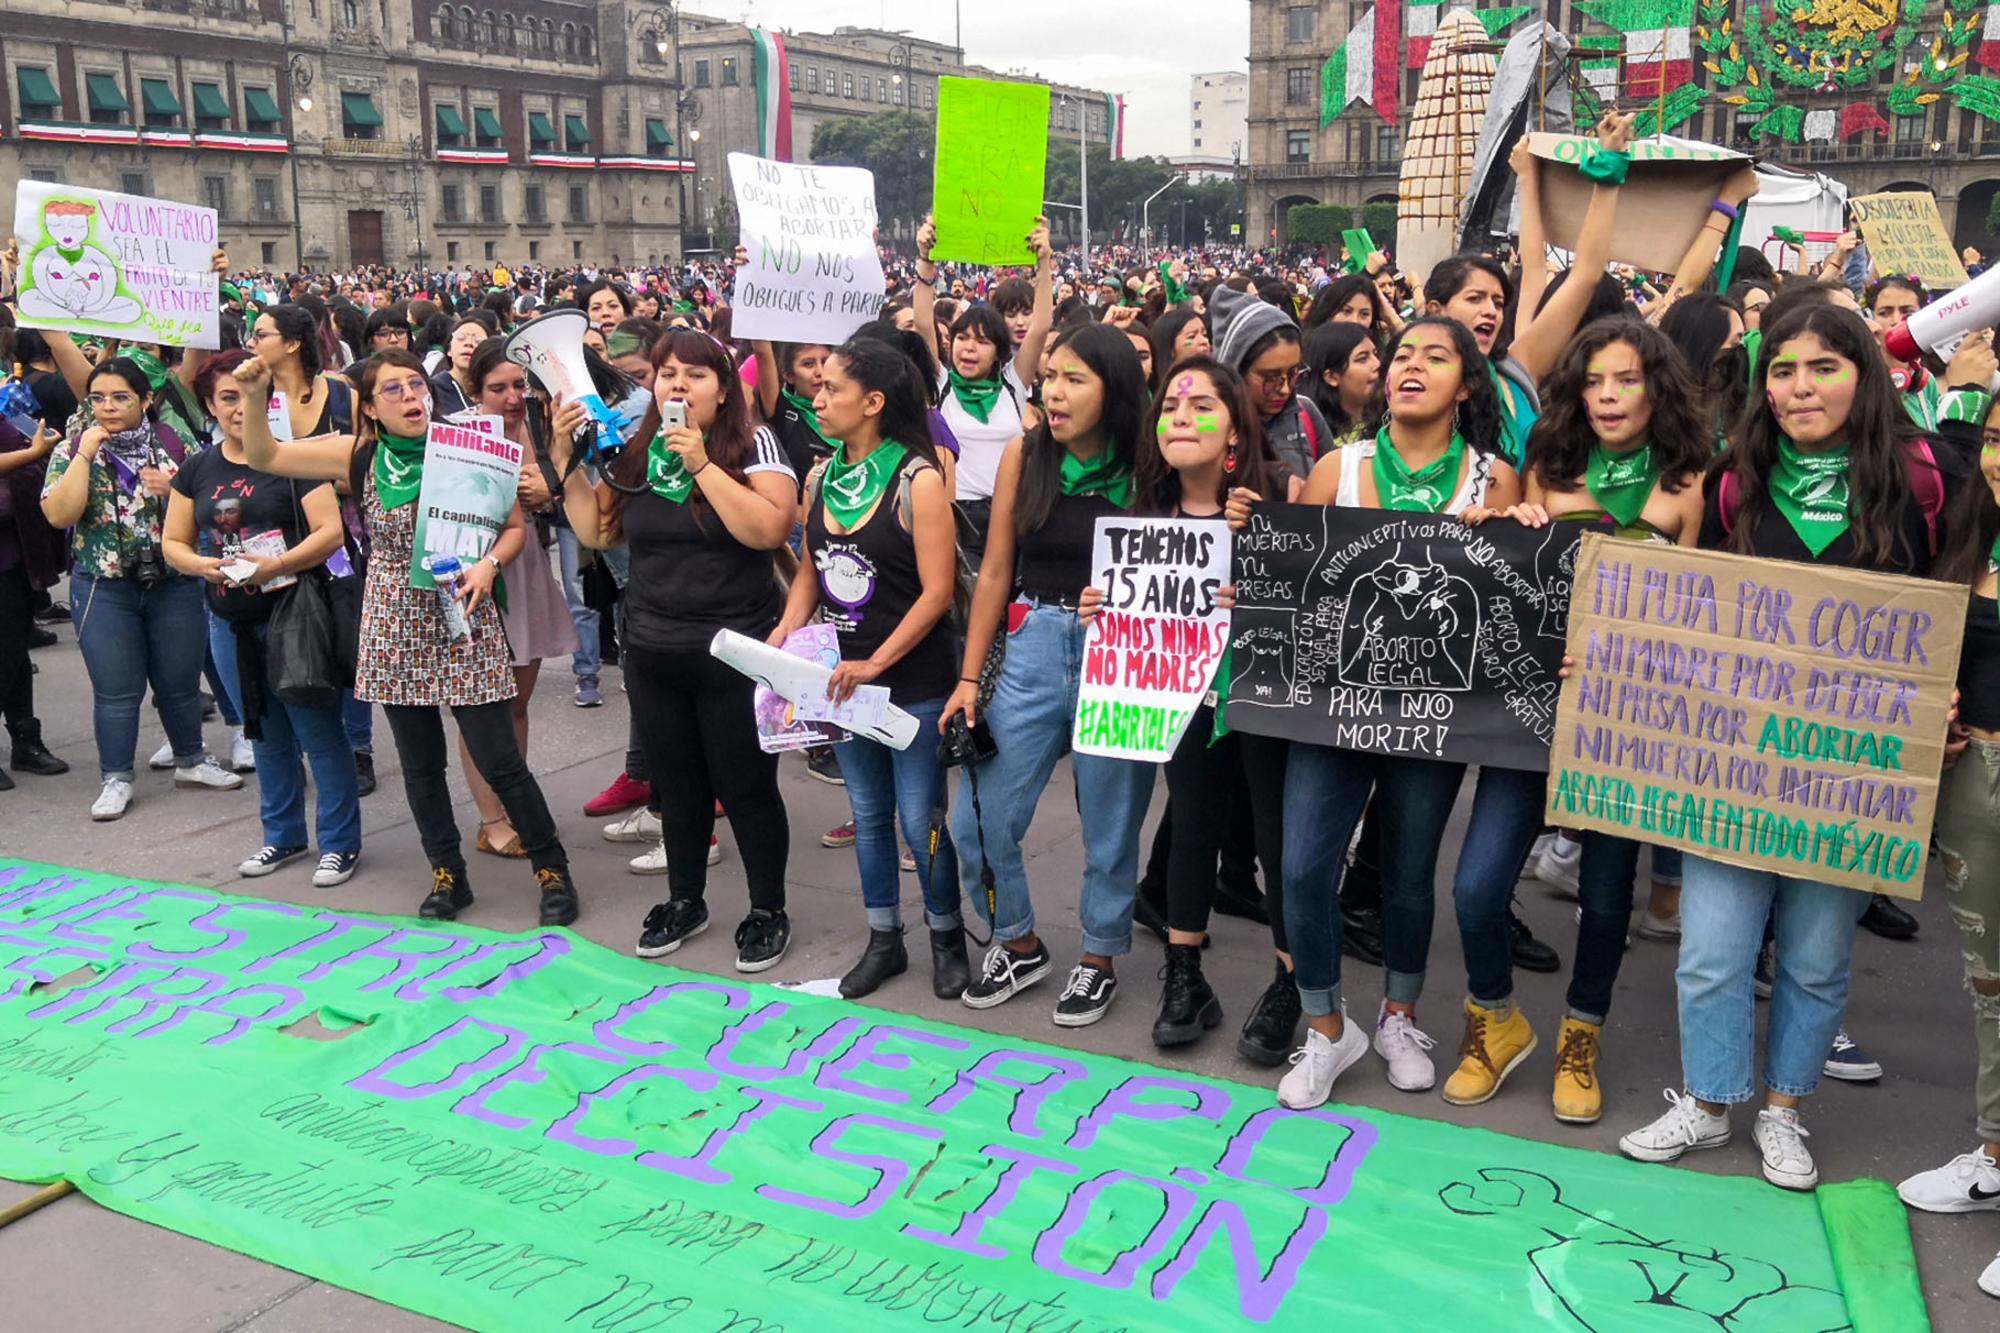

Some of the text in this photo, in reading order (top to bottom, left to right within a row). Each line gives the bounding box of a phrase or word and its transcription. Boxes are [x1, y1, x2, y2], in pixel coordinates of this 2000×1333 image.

[757, 161, 827, 189] NO TE
[742, 182, 875, 217] OBLIGAMOS A
[960, 185, 1002, 219] NO
[98, 200, 214, 244] VOLUNTARIO
[780, 215, 871, 240] ABORTAR
[113, 236, 176, 265] SEA EL
[761, 235, 854, 283] NO NOS
[125, 265, 214, 289] FRUTO DE TU
[743, 282, 815, 315] OBLIGUES
[822, 291, 833, 312] A
[141, 290, 214, 312] VIENTRE
[1938, 296, 1969, 320] PYLE
[431, 425, 520, 464] Militante
[428, 506, 440, 519] El
[1801, 511, 1843, 521] México
[1105, 526, 1214, 569] TENEMOS
[1237, 532, 1315, 552] MUERTAS
[1438, 522, 1473, 542] PARA
[1466, 536, 1496, 565] NO
[1489, 558, 1545, 610] ABORTAR
[1102, 568, 1221, 617] 15 AÑOS
[1594, 559, 1933, 667] NI PUTA POR COGER
[1090, 610, 1229, 659] SOMOS NIÑAS
[1311, 595, 1334, 684] SEXUAL PARA
[1358, 635, 1436, 664] ABORTO
[1477, 620, 1505, 678] SEGURO
[1489, 596, 1561, 713] ABORTO LEGAL
[1086, 648, 1211, 694] NO MADRES
[1294, 611, 1314, 705] EDUCACIÓN
[1367, 661, 1441, 685] LEGAL
[1586, 629, 1918, 728] NI MADRE POR DEBER
[1328, 686, 1453, 720] PARA NO
[1577, 674, 1904, 771] NI PRESA POR ABORTAR
[1336, 723, 1448, 756] MORIR!
[1574, 722, 1918, 825] NI MUERTA POR INTENTAR
[1552, 768, 1922, 884] ABORTO LEGAL EN TODO MÉXICO
[593, 981, 1380, 1204] CUERPO
[343, 1014, 1328, 1323] DECISIÓN
[372, 1229, 588, 1299] para
